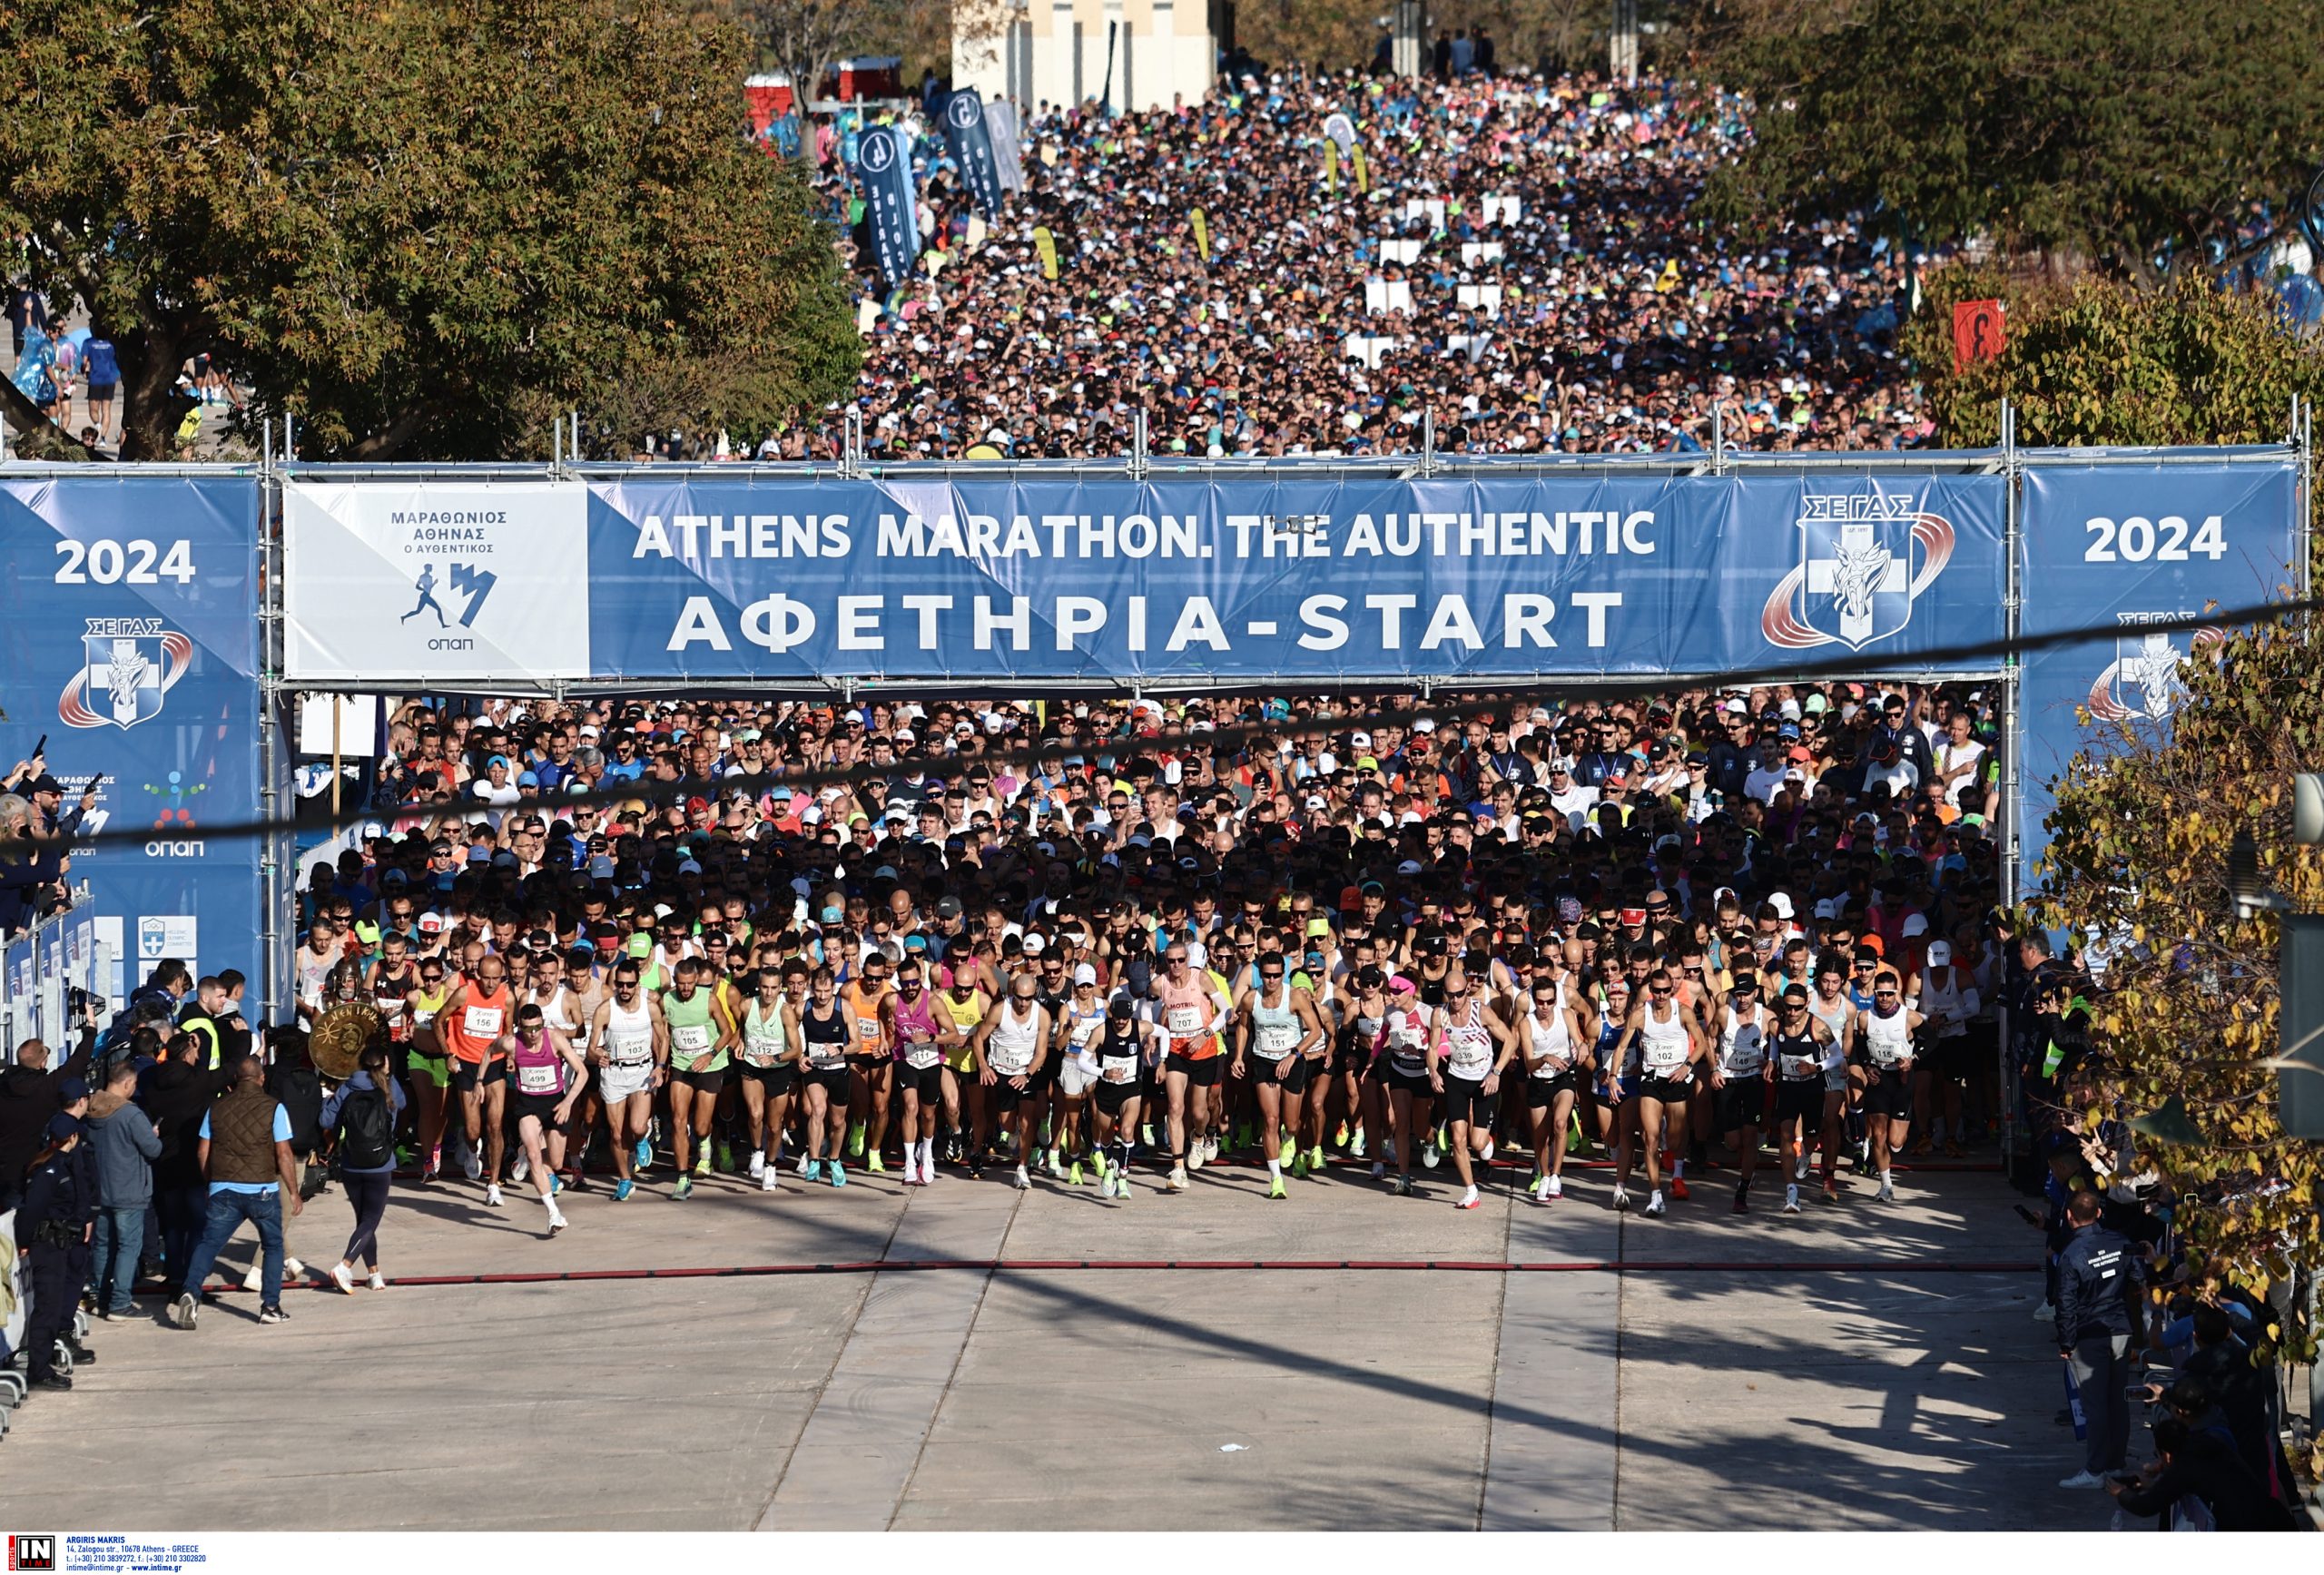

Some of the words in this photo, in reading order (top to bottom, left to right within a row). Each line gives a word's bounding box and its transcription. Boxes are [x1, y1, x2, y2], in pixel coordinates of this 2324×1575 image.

[1803, 495, 1914, 519] ΣΕΓΑΣ
[391, 512, 507, 524] ΜΑΡΑΘΩΝΙΟΣ
[413, 528, 485, 541] ΑΘΗΝΑΣ
[632, 515, 852, 558] ATHENS
[876, 514, 1213, 558] MARATHON.
[1226, 513, 1331, 558] THE
[1342, 510, 1656, 556] AUTHENTIC
[2084, 516, 2228, 562] 2024
[404, 545, 412, 553] Ο
[417, 544, 494, 553] ΑΥΘΕΝΤΙΚΟΣ
[54, 539, 196, 584] 2024
[84, 618, 162, 635] ΣΕΓΑΣ
[477, 1019, 491, 1027] 156
[683, 1037, 698, 1045] 105
[628, 1047, 643, 1055] 103
[1006, 1057, 1019, 1065] 113
